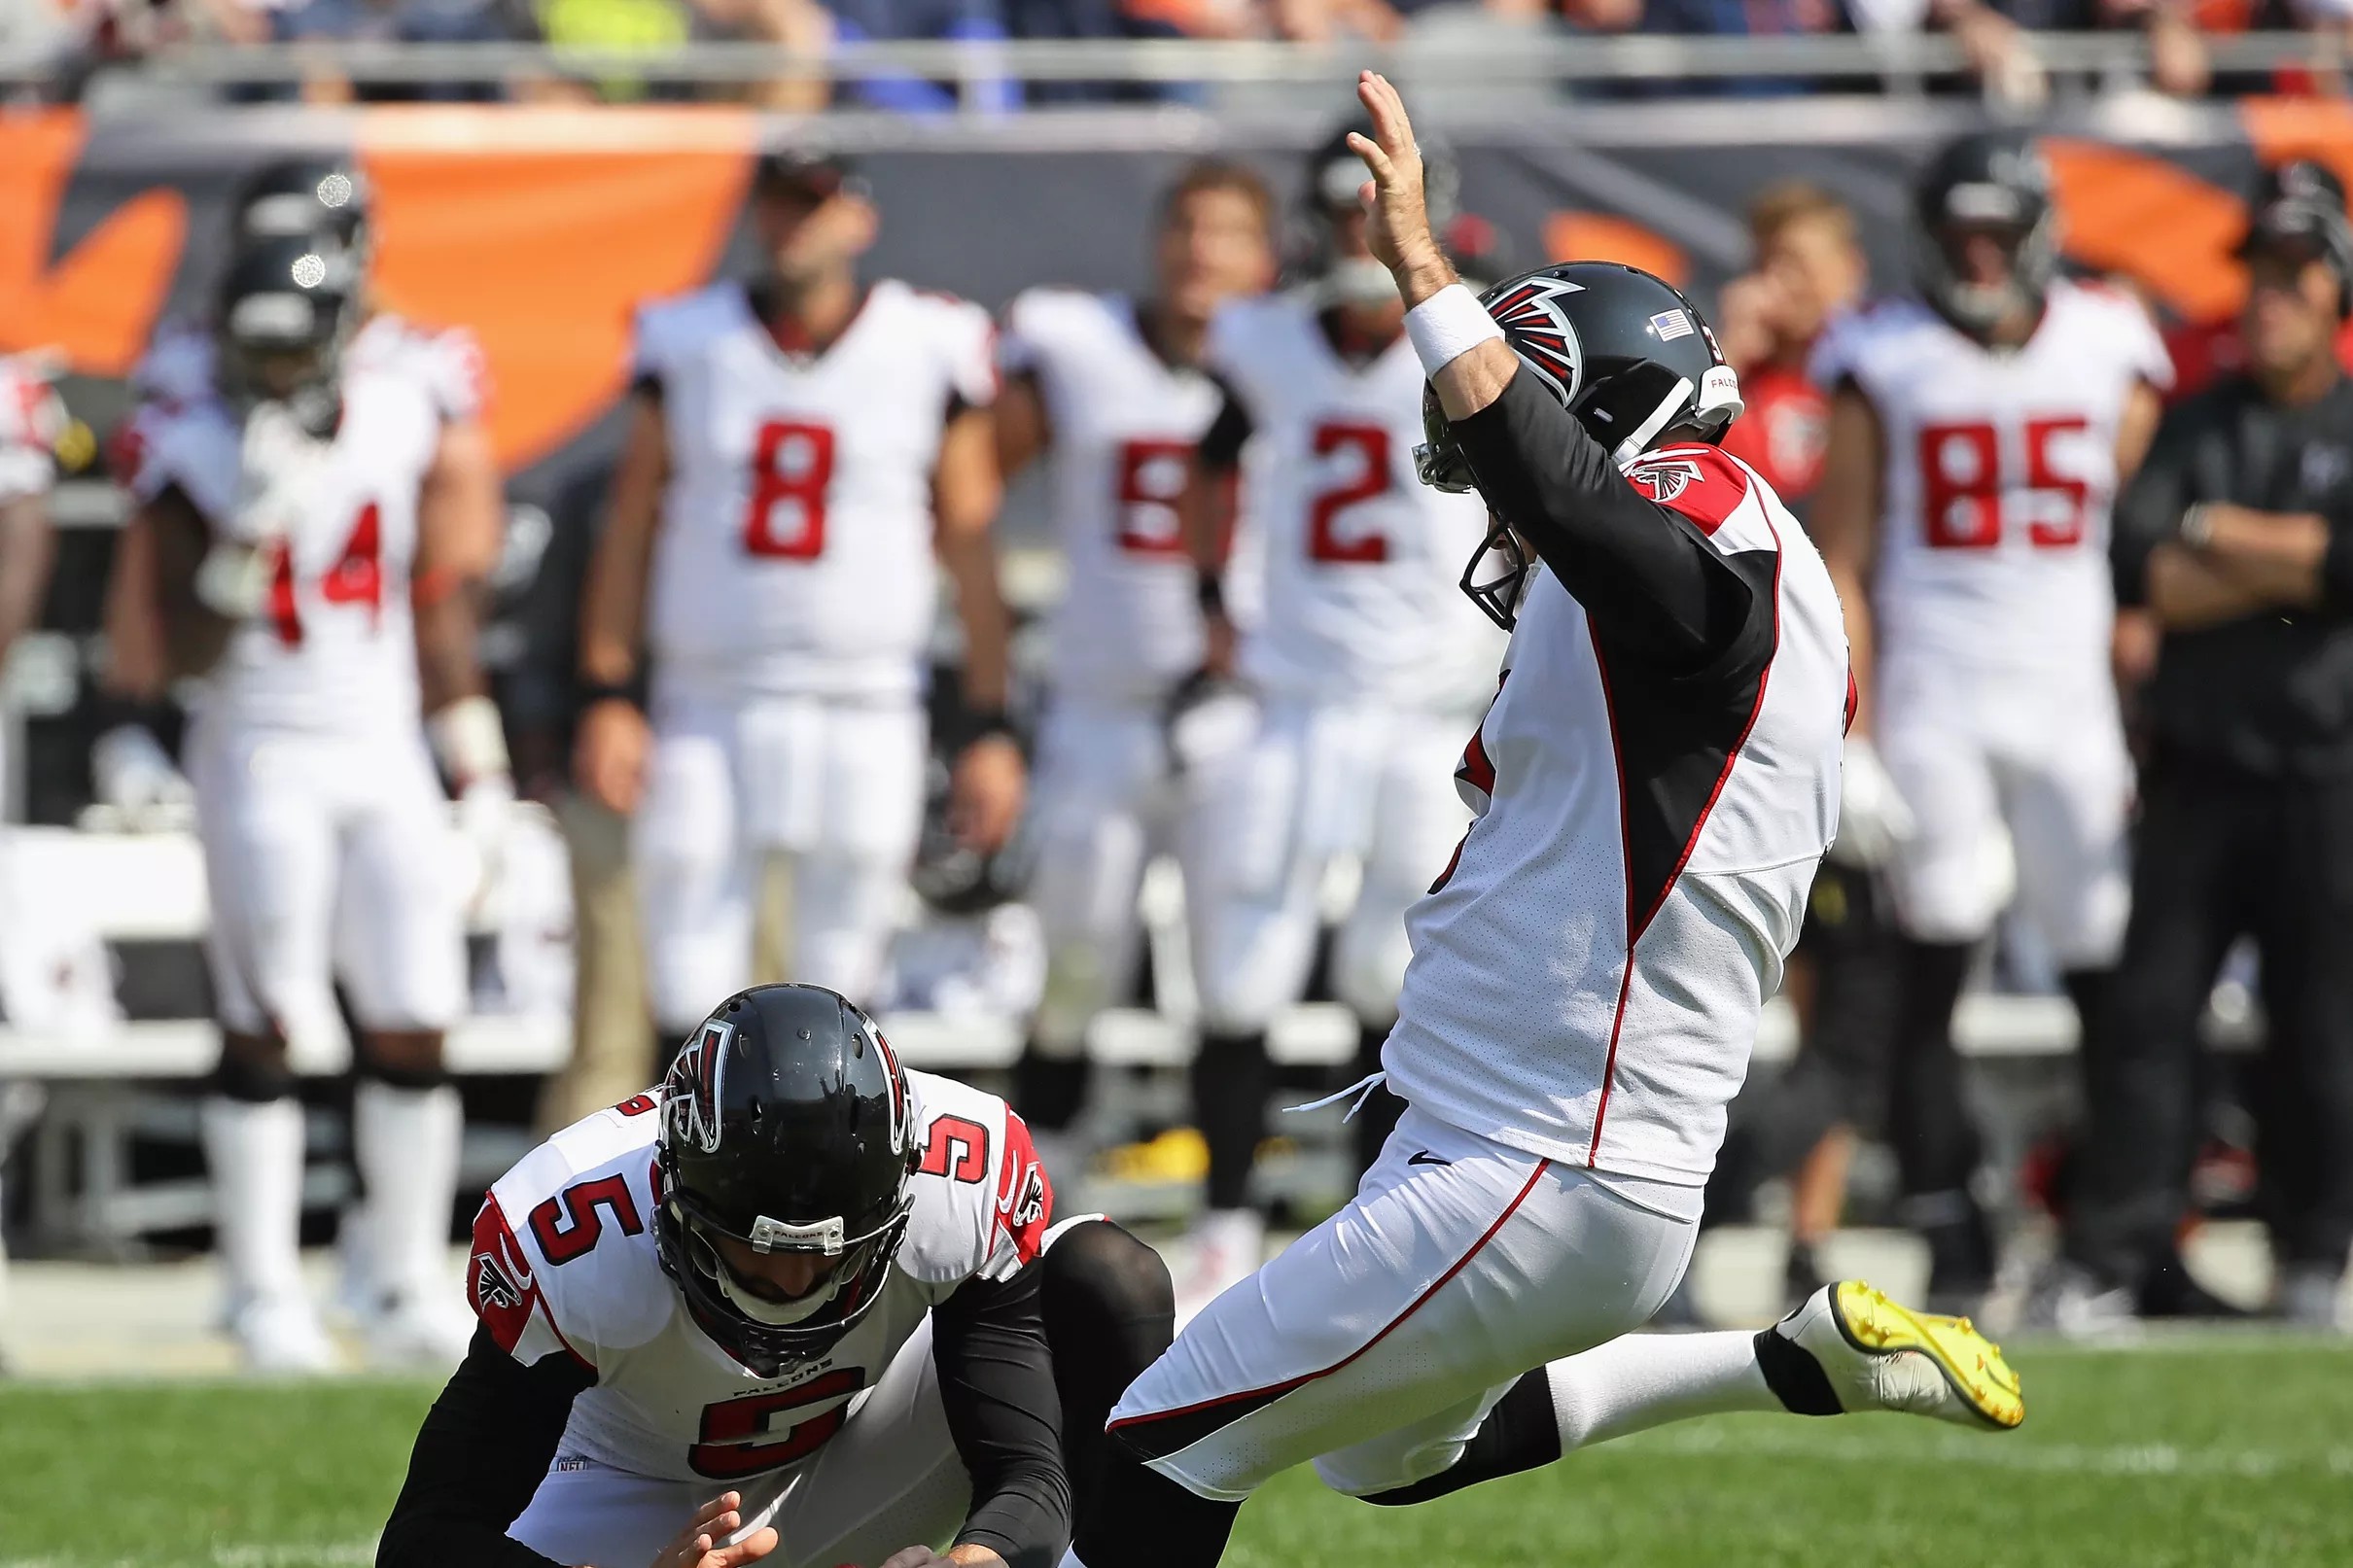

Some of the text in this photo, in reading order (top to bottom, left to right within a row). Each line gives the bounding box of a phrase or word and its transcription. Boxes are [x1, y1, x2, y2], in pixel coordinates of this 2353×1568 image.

[747, 419, 834, 559] 8
[1308, 422, 1390, 564] 2
[1919, 417, 2089, 550] 85
[916, 1113, 989, 1184] 5
[528, 1172, 644, 1267] 5
[774, 1230, 825, 1239] FALCONS
[687, 1366, 865, 1481] 5
[733, 1358, 833, 1397] FALCONS
